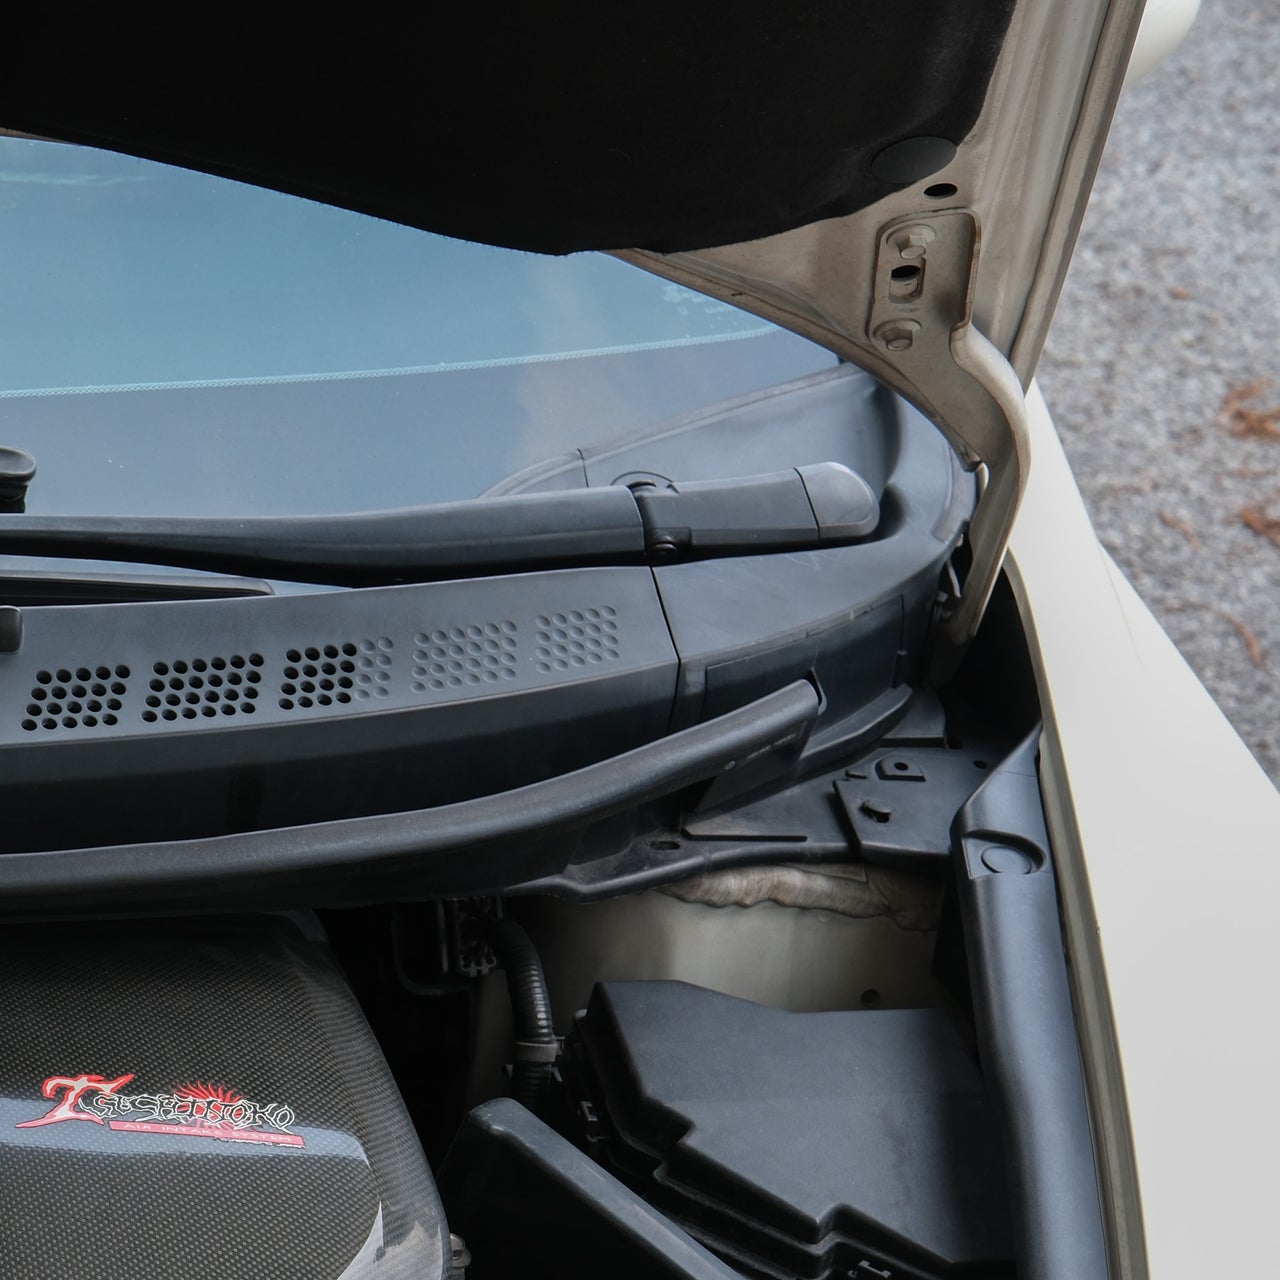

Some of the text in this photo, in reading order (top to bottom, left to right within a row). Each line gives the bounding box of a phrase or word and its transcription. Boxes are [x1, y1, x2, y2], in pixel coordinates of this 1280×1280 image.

[125, 1123, 292, 1142] AIR INTAKE SYSTEM
